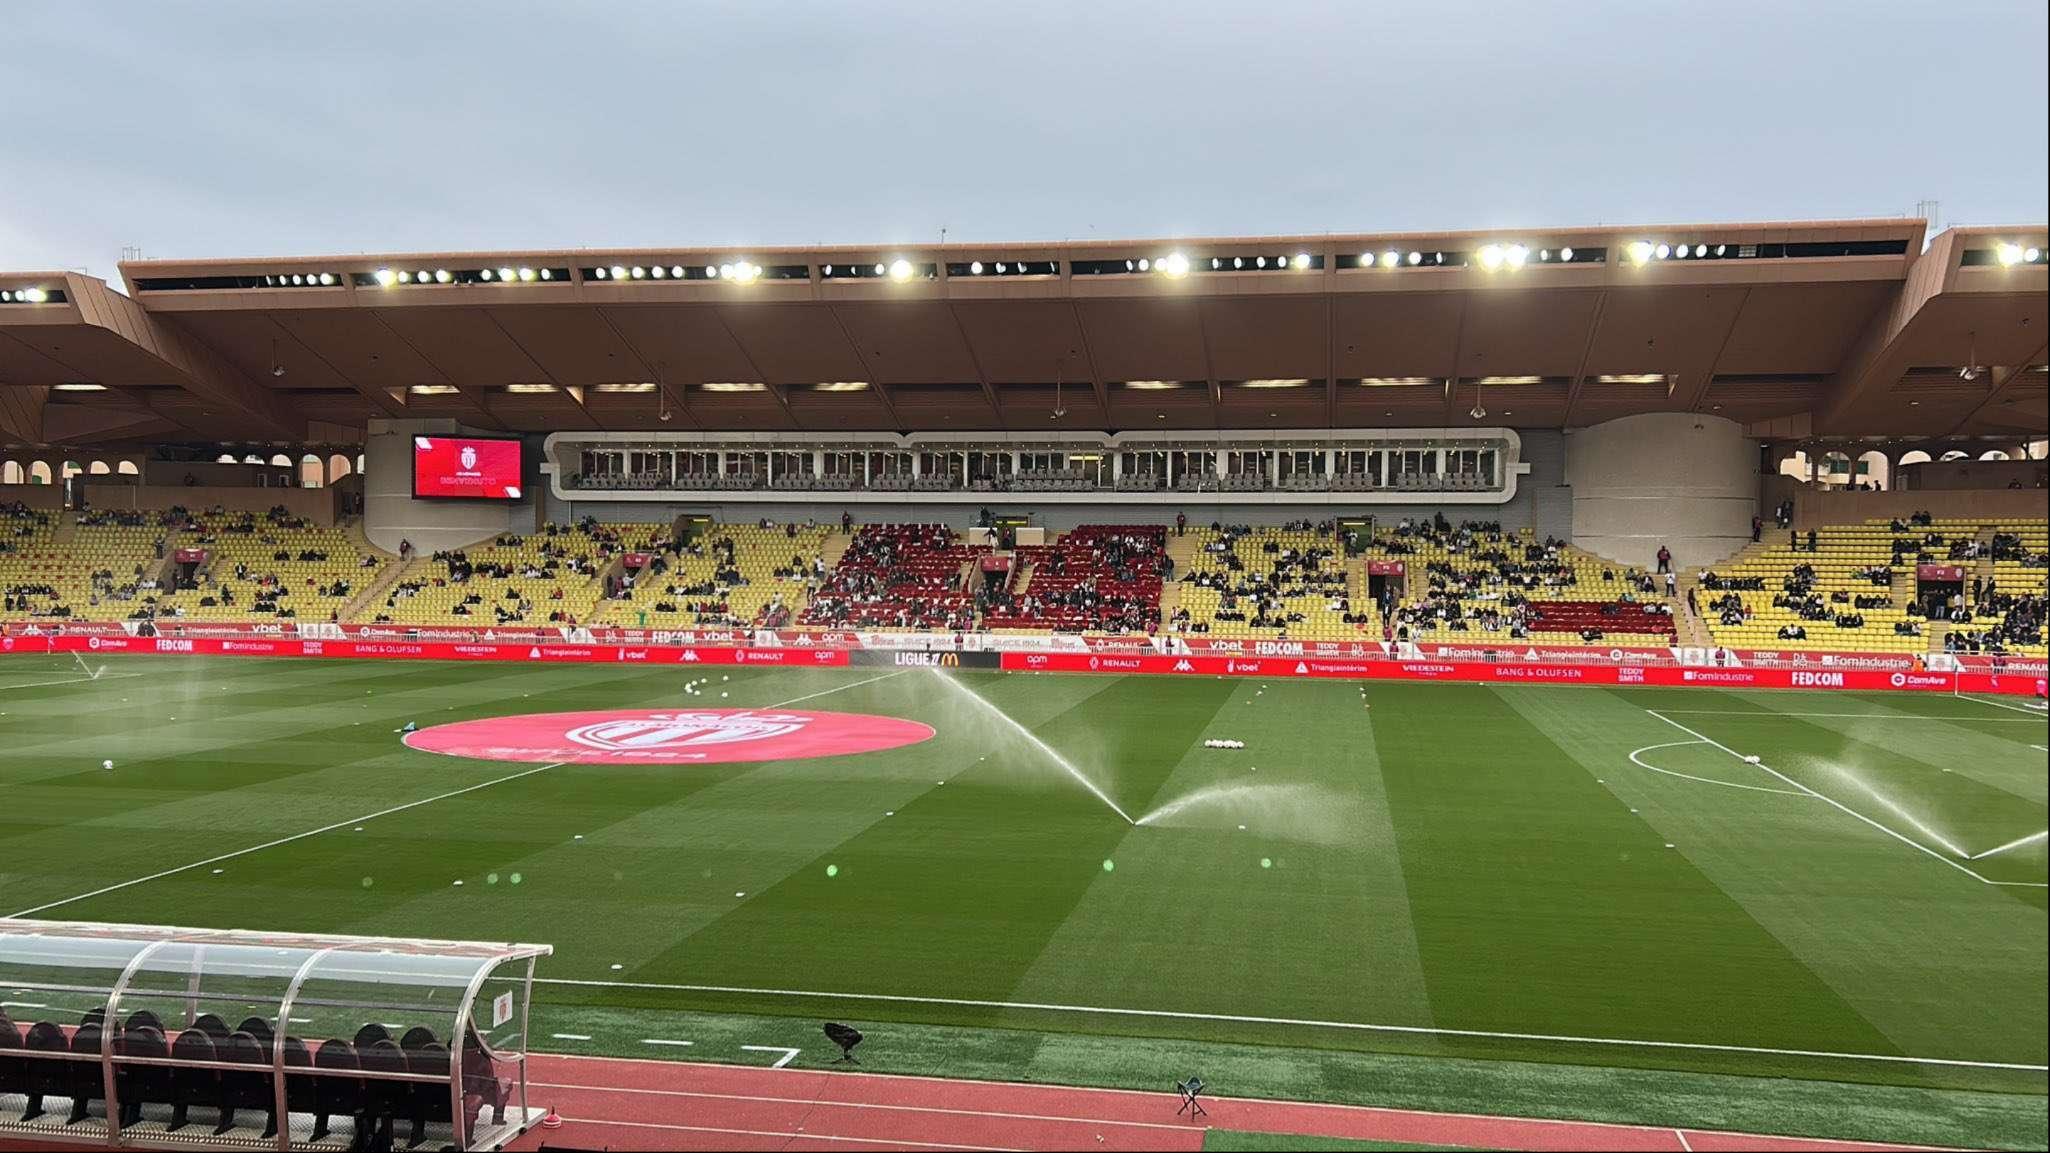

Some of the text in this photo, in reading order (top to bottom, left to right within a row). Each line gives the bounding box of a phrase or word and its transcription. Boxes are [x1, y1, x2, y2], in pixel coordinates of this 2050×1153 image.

[252, 623, 283, 633] vbet
[702, 630, 735, 641] vbet
[156, 640, 192, 651] FEDCOM
[1210, 641, 1242, 651] vbet
[1256, 642, 1303, 655] FEDCOM
[626, 651, 646, 659] vbet
[748, 652, 783, 660] RENAULT
[895, 652, 931, 666] LIGUE
[1102, 659, 1141, 668] RENAULT
[1237, 664, 1259, 672] vbet
[1496, 668, 1524, 676] BANG
[1535, 669, 1582, 678] OLUFSEN
[1791, 672, 1843, 686] FEDCOM
